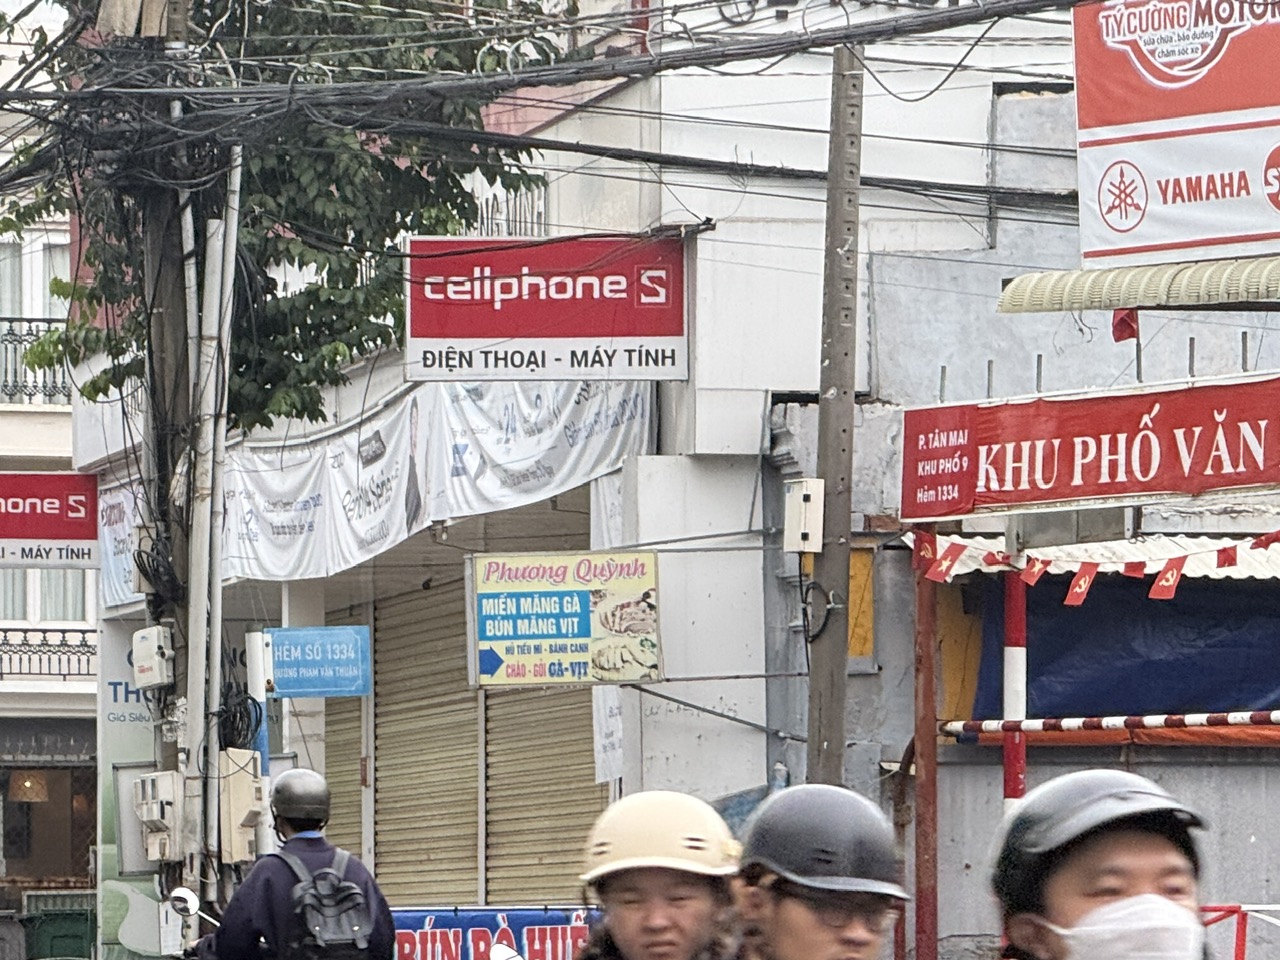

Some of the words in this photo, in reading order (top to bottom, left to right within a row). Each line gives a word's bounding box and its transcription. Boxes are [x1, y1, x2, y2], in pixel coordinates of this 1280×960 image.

[1127, 4, 1188, 33] CƯỜNG
[1157, 170, 1251, 206] YAMAHA
[424, 266, 627, 310] cellphone
[422, 346, 471, 372] ĐIỆN
[480, 349, 546, 372] THOẠI
[570, 345, 618, 368] MÁY
[624, 345, 676, 367] TÍNH
[928, 428, 948, 449] TÂN
[949, 429, 968, 447] MAI
[975, 438, 1061, 494] KHU
[1070, 402, 1162, 487] PHỐ
[1173, 408, 1269, 479] VĂN
[918, 459, 938, 476] KHU
[939, 451, 961, 474] PHỐ
[962, 456, 968, 472] 9
[916, 485, 936, 504] Hẻm
[938, 484, 959, 501] 1334
[21, 545, 52, 560] MÁY
[57, 545, 91, 560] TÍNH
[484, 561, 568, 585] Phương
[574, 557, 647, 585] Quỳnh
[482, 592, 517, 616] MIẾN
[520, 594, 560, 615] MĂNG
[563, 592, 582, 614] GÀ
[486, 618, 513, 636] BÚN
[517, 616, 556, 636] MĂNG
[560, 617, 579, 637] VỊT
[305, 640, 322, 661] SỐ
[326, 644, 355, 661] 1334
[107, 712, 126, 723] Giá
[128, 712, 151, 723] Siêu
